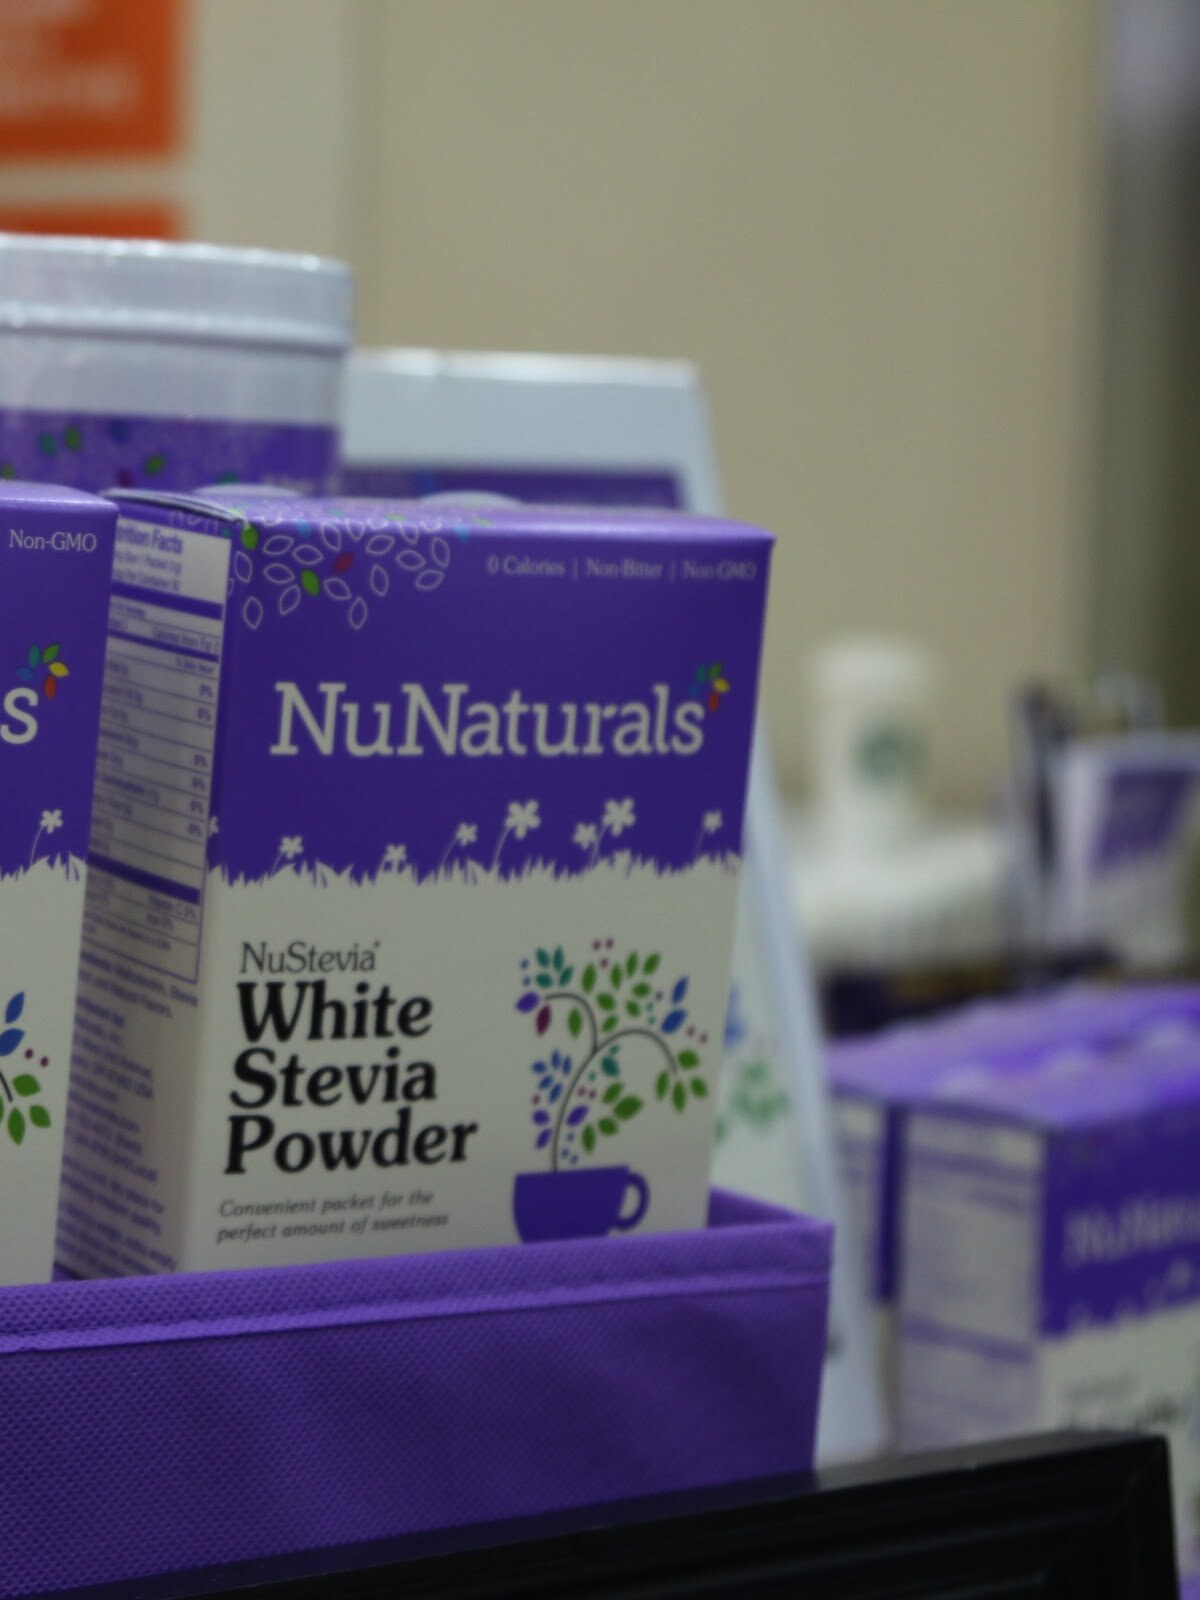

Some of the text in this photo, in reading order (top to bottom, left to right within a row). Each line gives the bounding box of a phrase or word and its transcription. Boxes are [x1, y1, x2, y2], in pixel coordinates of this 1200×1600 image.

[9, 529, 98, 552] Non-GMO
[504, 555, 565, 577] Calories
[585, 557, 663, 578] Non-Bitter
[269, 681, 706, 757] NuNaturals
[236, 979, 433, 1043] White
[229, 1046, 437, 1110] Stevia
[224, 1106, 480, 1176] Powder
[219, 1188, 434, 1218] Convenient packet for the
[217, 1223, 277, 1245] perfect
[282, 1220, 346, 1239] amount
[351, 1216, 370, 1236] of
